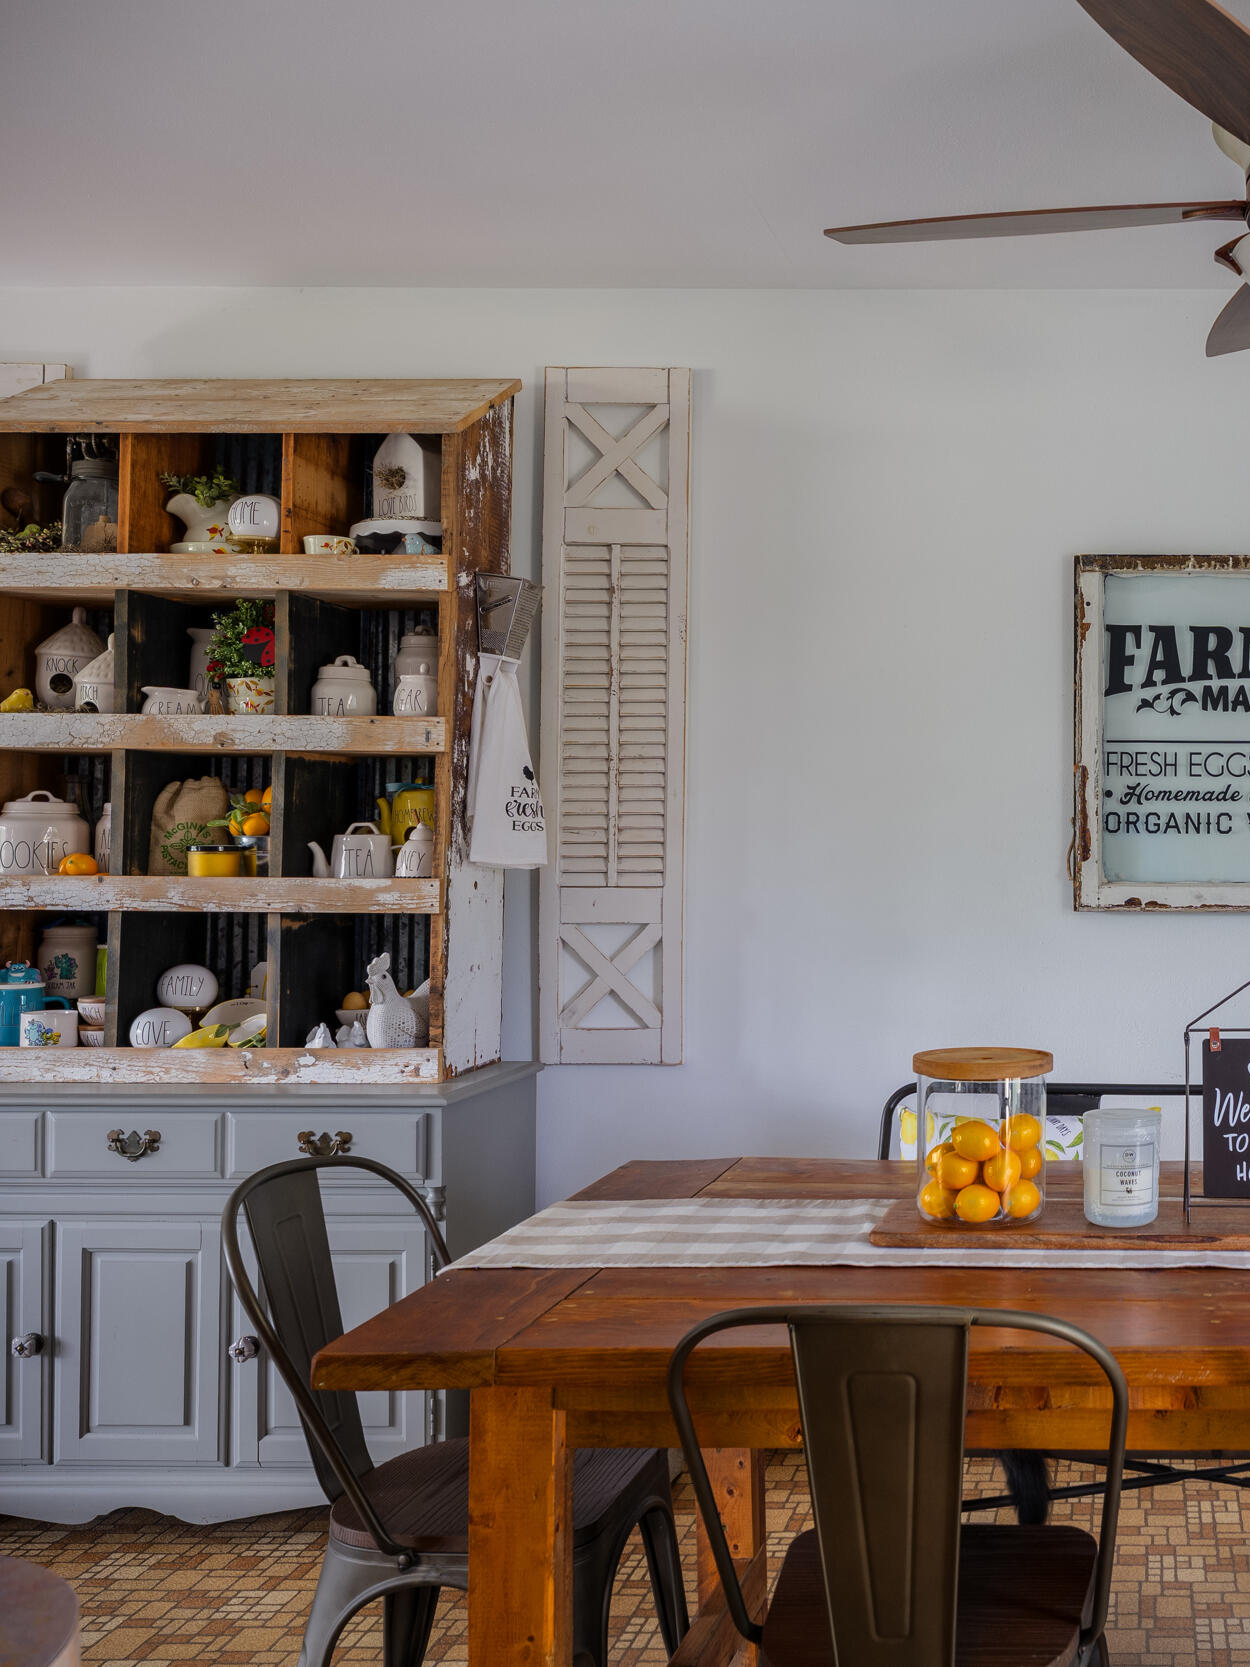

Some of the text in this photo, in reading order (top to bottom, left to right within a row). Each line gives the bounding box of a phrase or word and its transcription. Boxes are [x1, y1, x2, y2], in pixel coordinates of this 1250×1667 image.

[377, 497, 396, 517] LOVE
[45, 657, 79, 674] KNOCK
[148, 701, 197, 715] CREAM
[317, 697, 345, 716] TEA
[396, 688, 423, 712] GAR
[1106, 751, 1177, 777] FRESH
[1119, 782, 1243, 806] Homemade
[505, 799, 544, 819] fresh
[512, 820, 544, 832] EGGS
[1104, 811, 1233, 835] ORGANIC
[0, 840, 69, 869] OOKIES
[344, 848, 375, 877] TEA
[397, 850, 426, 872] NEY
[160, 975, 205, 997] FAMILY
[136, 1020, 171, 1046] LOVE
[1223, 1133, 1249, 1153] TO
[1115, 1170, 1142, 1178] COCONUT
